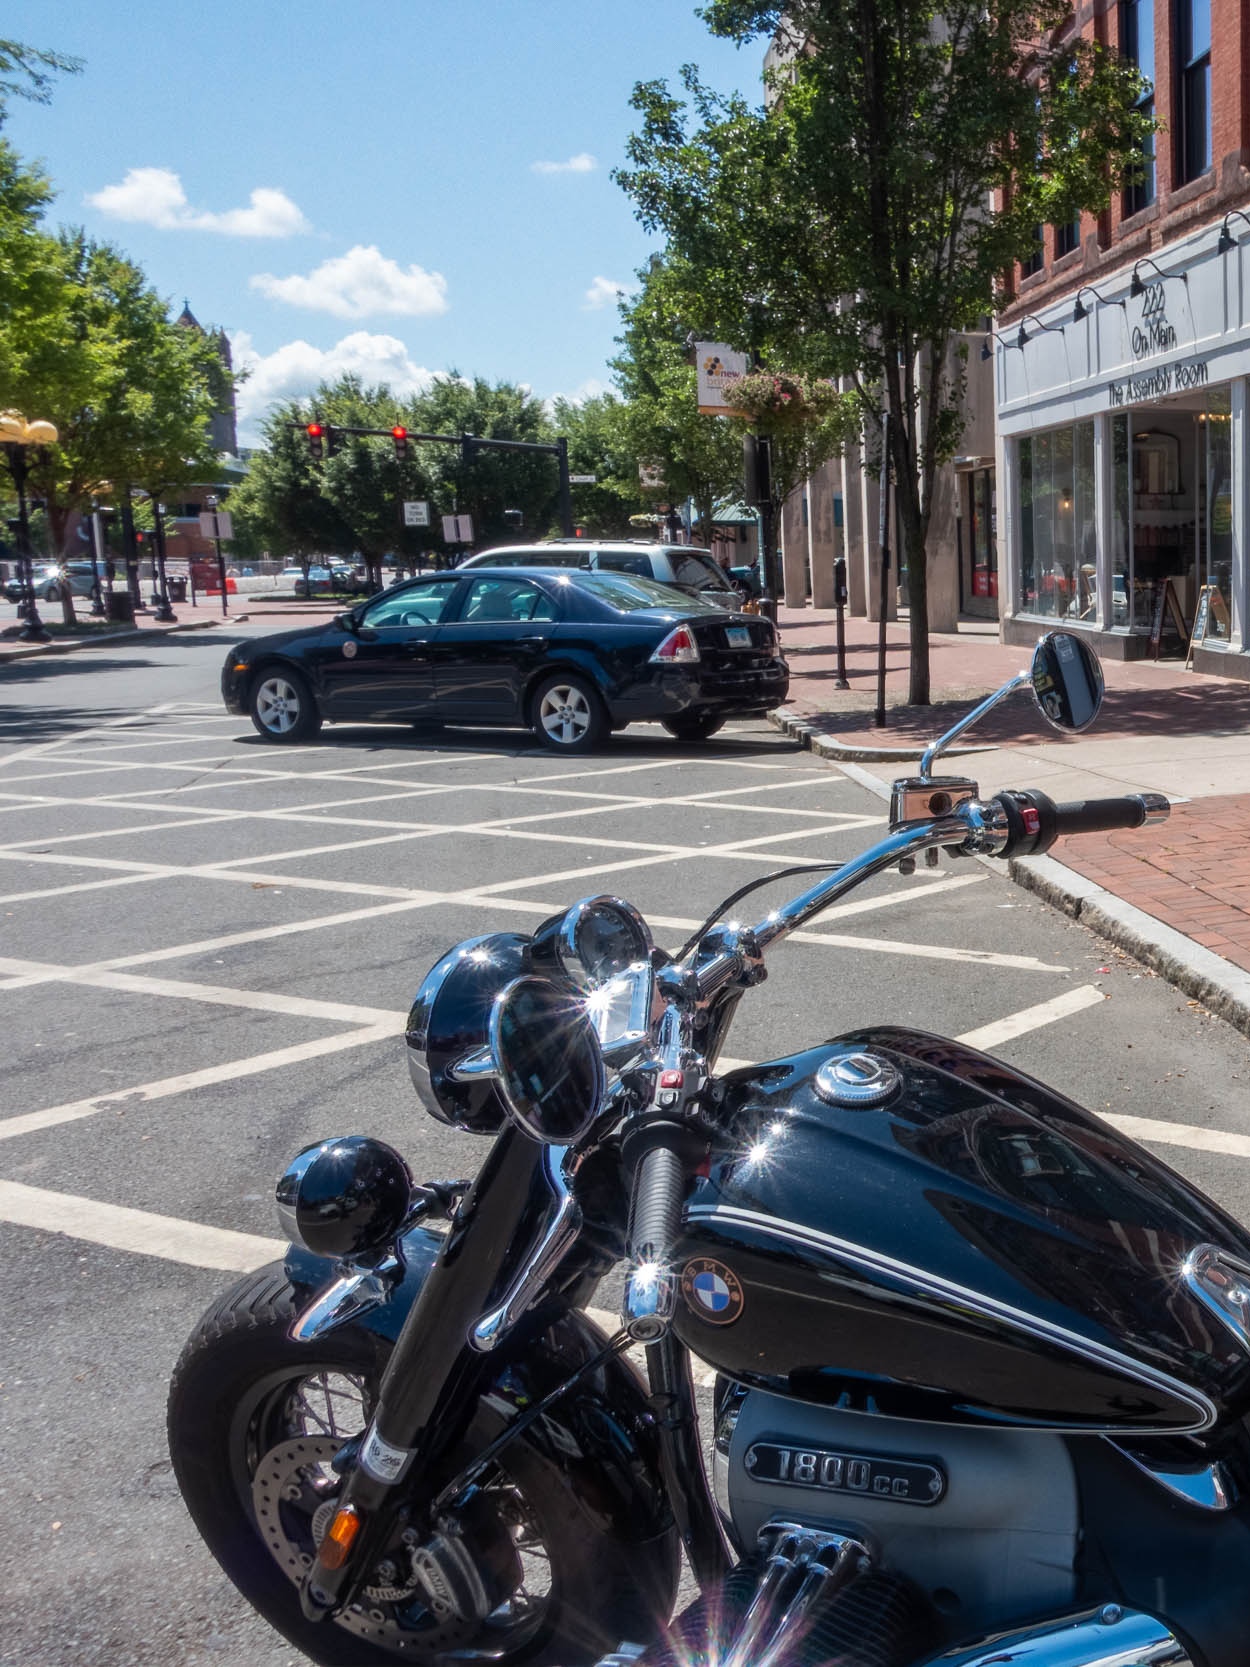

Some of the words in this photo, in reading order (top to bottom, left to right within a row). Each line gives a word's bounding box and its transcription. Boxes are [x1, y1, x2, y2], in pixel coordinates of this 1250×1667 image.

[1142, 282, 1165, 317] 222
[1132, 326, 1149, 354] On
[1150, 319, 1175, 347] Main
[1109, 383, 1124, 405] The
[1126, 367, 1171, 400] Assembly
[1175, 362, 1208, 388] Room
[686, 1261, 737, 1287] BMW
[777, 1450, 909, 1497] 1800cc
